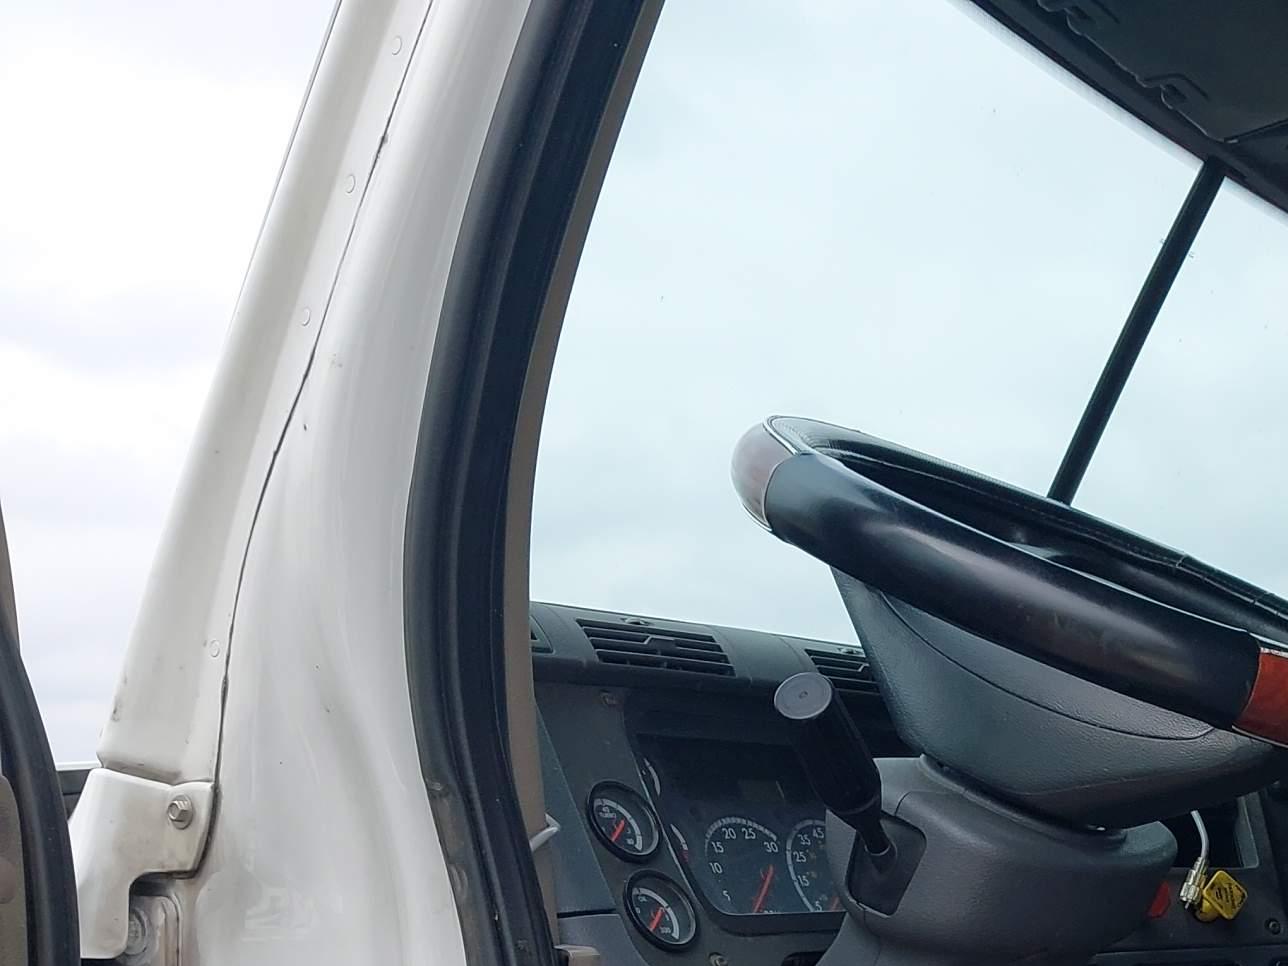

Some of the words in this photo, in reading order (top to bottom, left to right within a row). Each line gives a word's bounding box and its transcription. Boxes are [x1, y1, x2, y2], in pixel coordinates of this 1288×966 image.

[721, 827, 737, 840] 20
[741, 827, 756, 840] 25
[812, 827, 825, 839] 45
[797, 834, 811, 846] 35
[711, 841, 724, 853] 15
[763, 841, 779, 853] 30
[793, 851, 807, 862] 25
[709, 862, 722, 874] 10
[798, 875, 810, 887] 15
